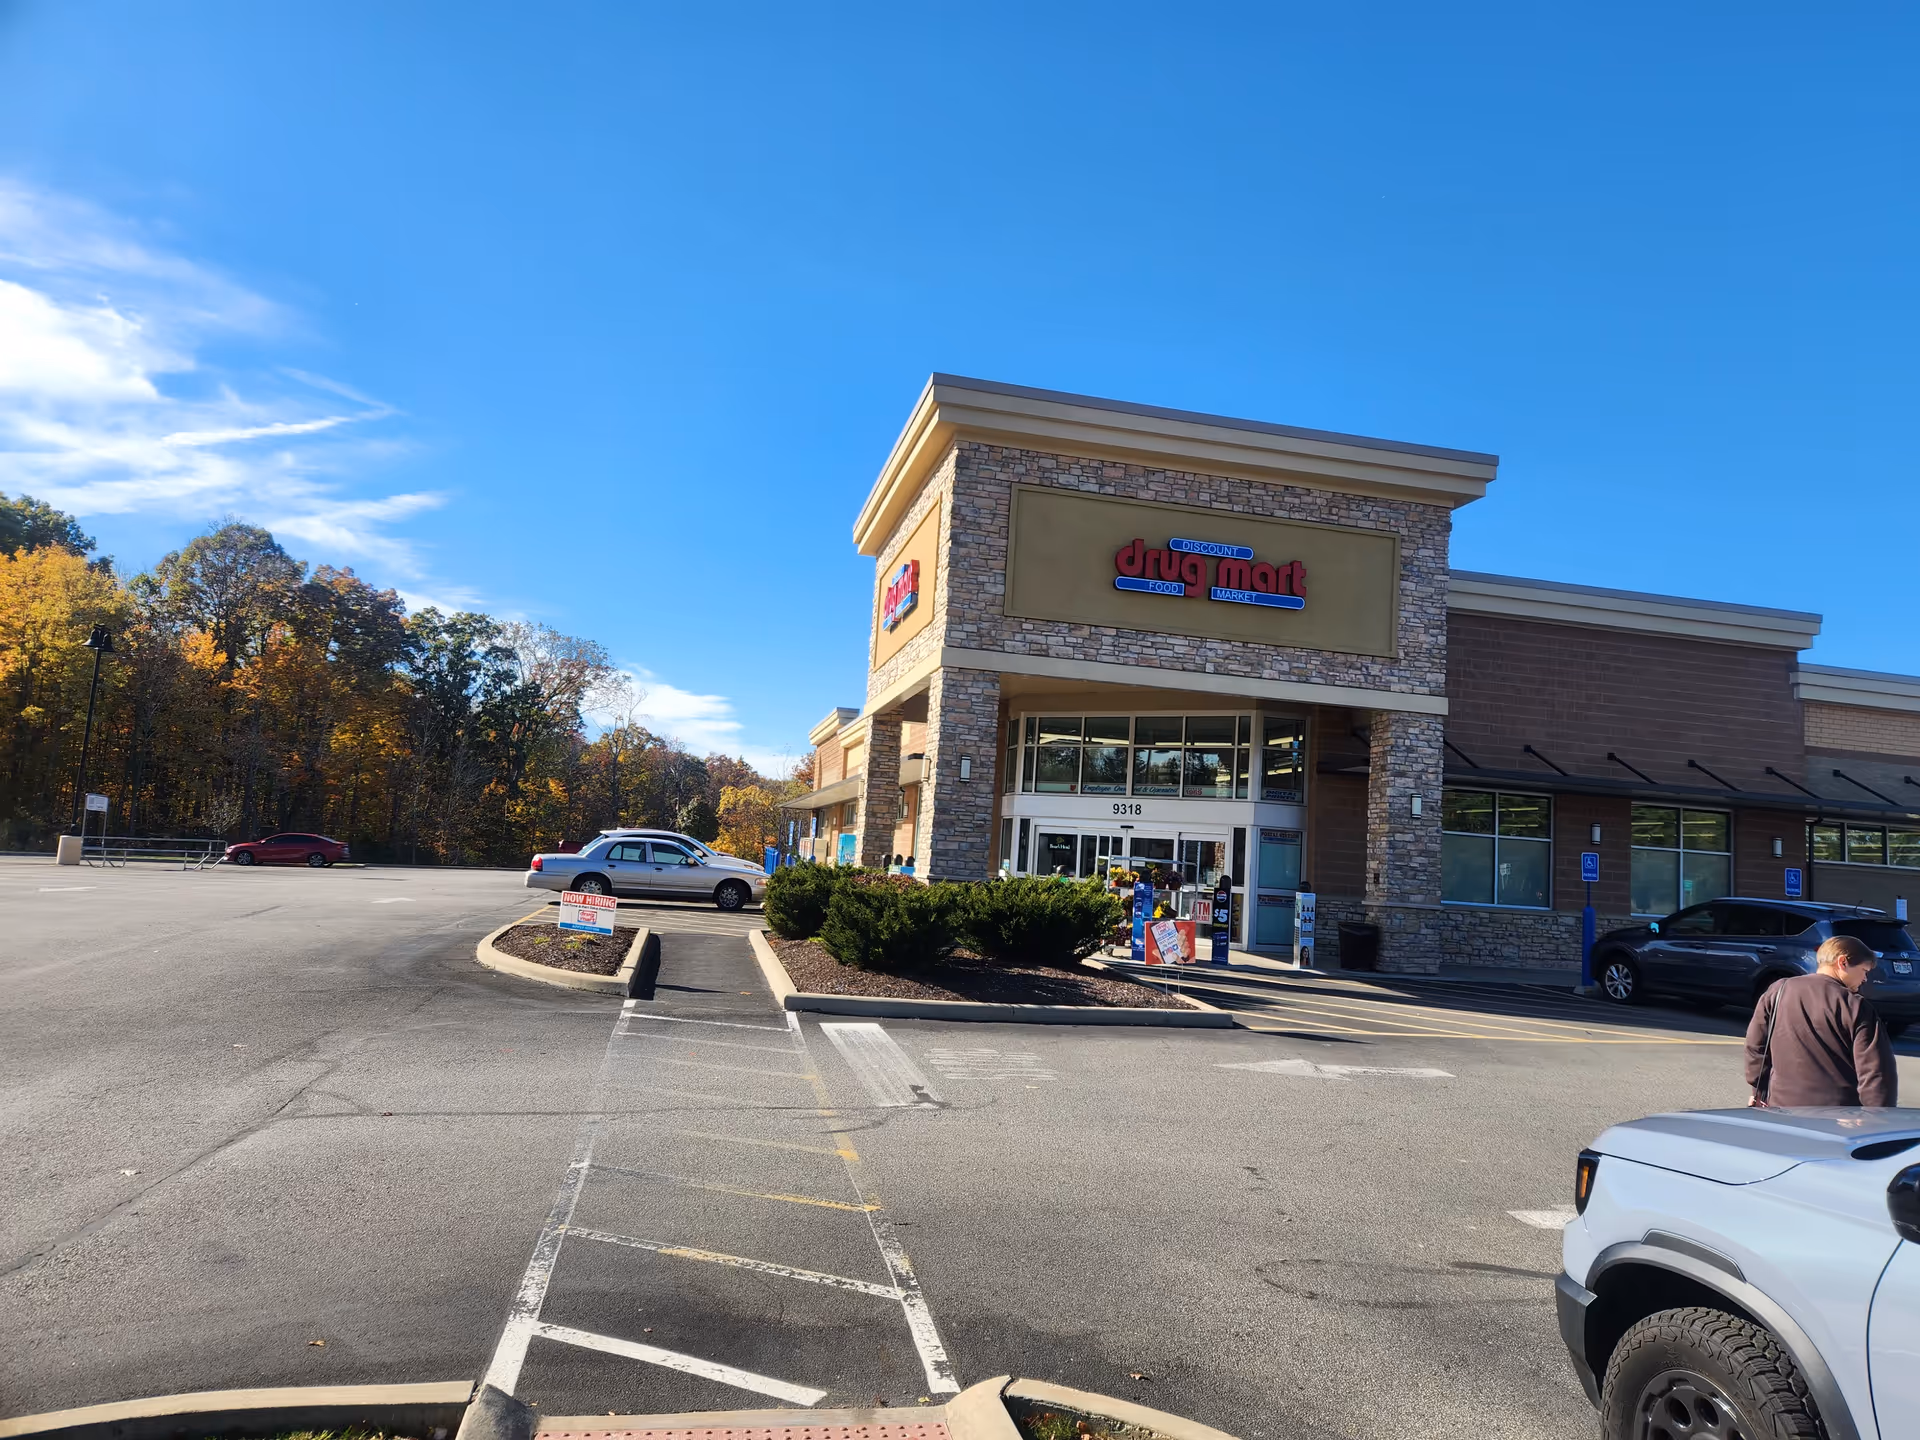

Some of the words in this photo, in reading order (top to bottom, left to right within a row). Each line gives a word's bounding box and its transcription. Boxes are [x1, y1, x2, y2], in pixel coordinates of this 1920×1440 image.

[1182, 541, 1239, 557] DISCOUNT
[1115, 538, 1207, 597] drug
[1216, 558, 1307, 597] mart
[1149, 582, 1179, 593] FOOD
[1216, 589, 1257, 602] MARKET
[1113, 804, 1142, 815] 9318
[564, 893, 584, 903] NOW
[586, 895, 615, 907] HIRING
[1192, 902, 1210, 915] ATM
[1214, 908, 1229, 922] $5
